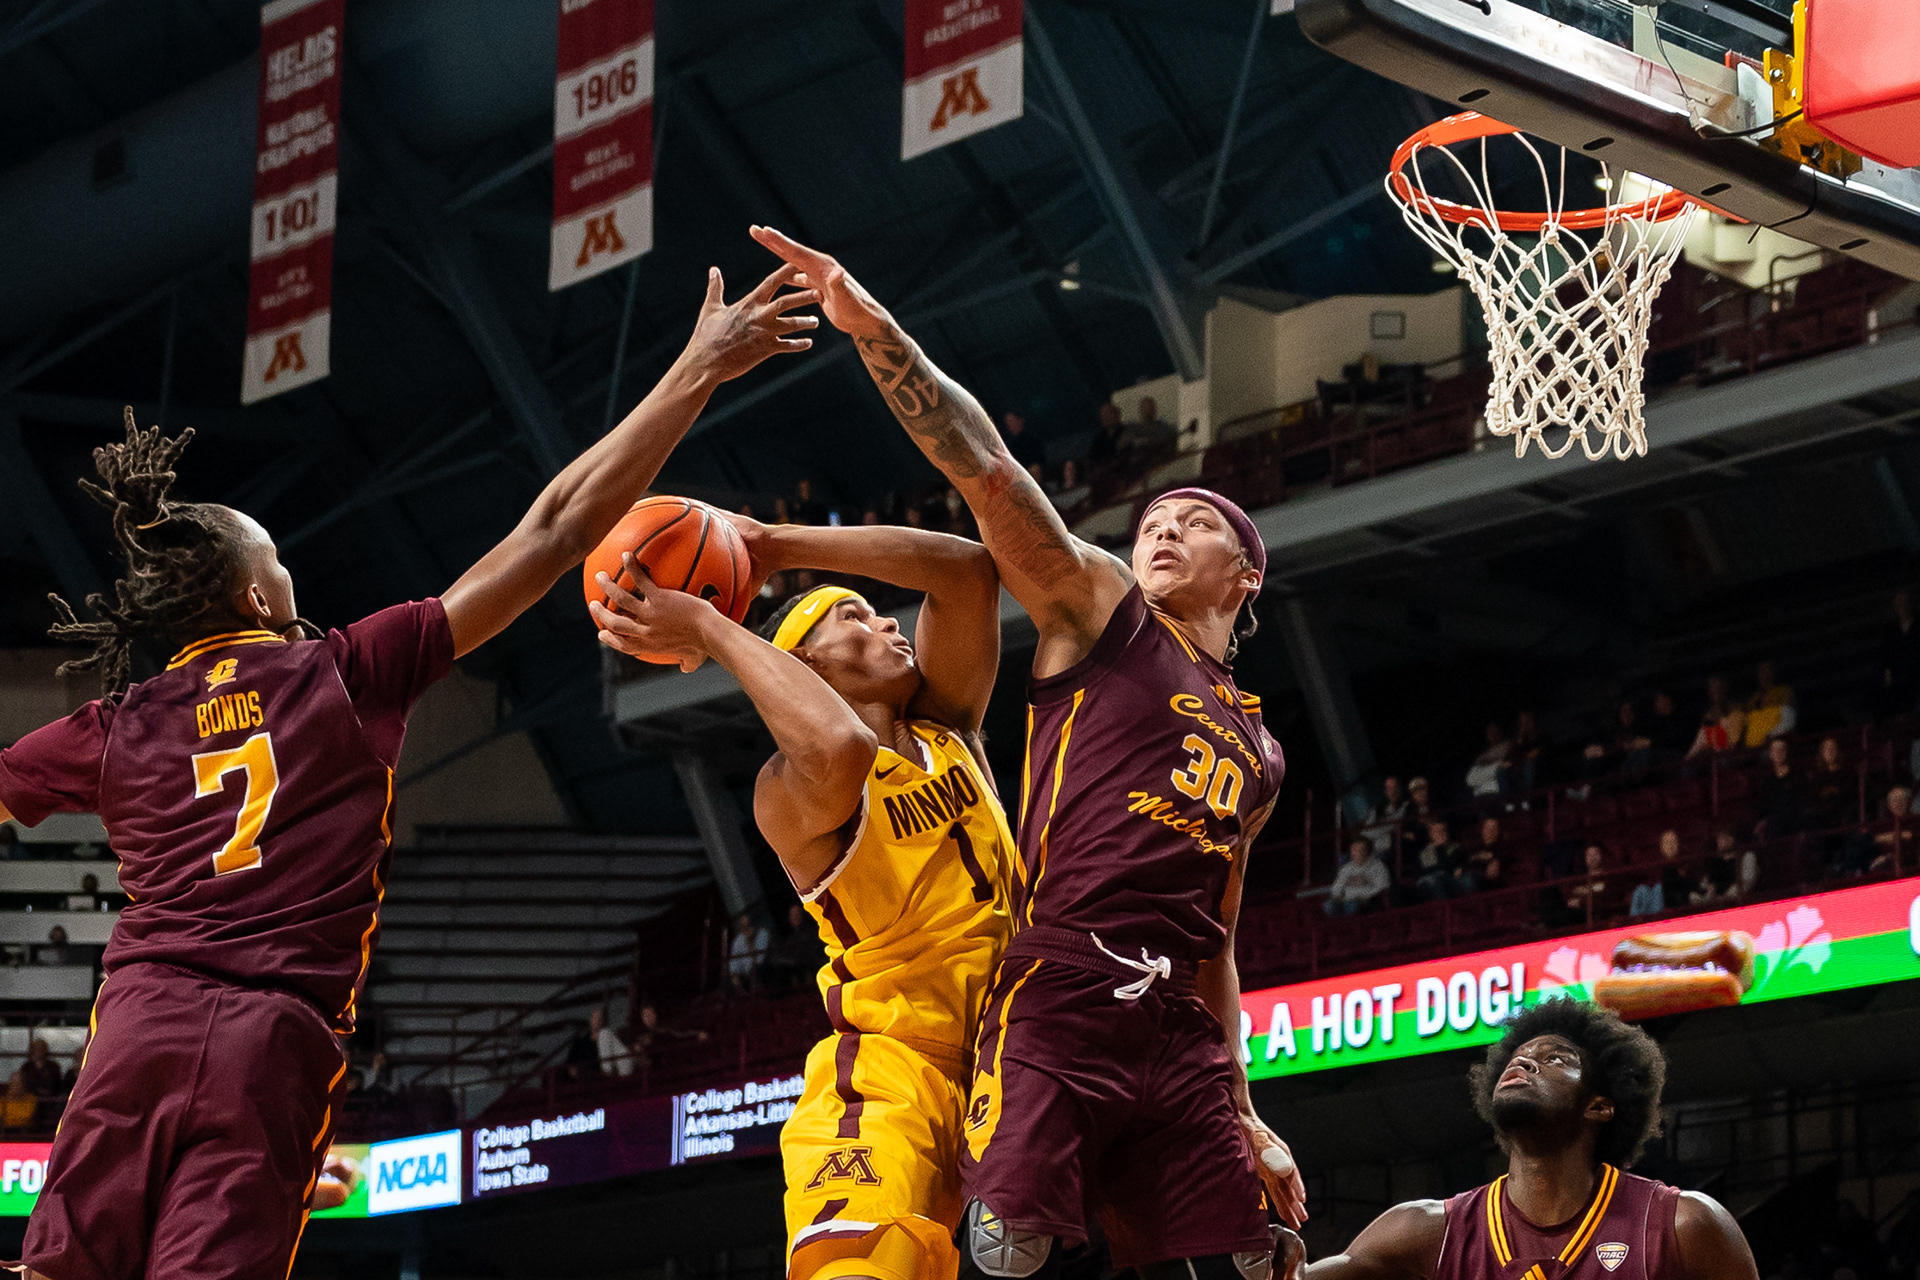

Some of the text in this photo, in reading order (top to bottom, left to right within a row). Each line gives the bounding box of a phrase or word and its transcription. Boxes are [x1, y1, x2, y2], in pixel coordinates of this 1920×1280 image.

[196, 690, 264, 738] BONDS
[1170, 733, 1244, 821] 30
[191, 731, 280, 877] 7
[949, 821, 994, 903] 1
[1264, 1001, 1297, 1061] A
[1311, 982, 1402, 1055] HOT
[1416, 961, 1526, 1038] DOG!
[685, 1088, 742, 1114] College
[478, 1107, 605, 1149] College Basketball
[684, 1131, 735, 1158] Illinois
[2, 1159, 48, 1194] FO
[375, 1152, 448, 1194] NCAA
[478, 1148, 530, 1171] Auburn
[479, 1163, 549, 1191] Iowa State
[804, 1145, 882, 1193] M
[1599, 1250, 1626, 1259] MAC
